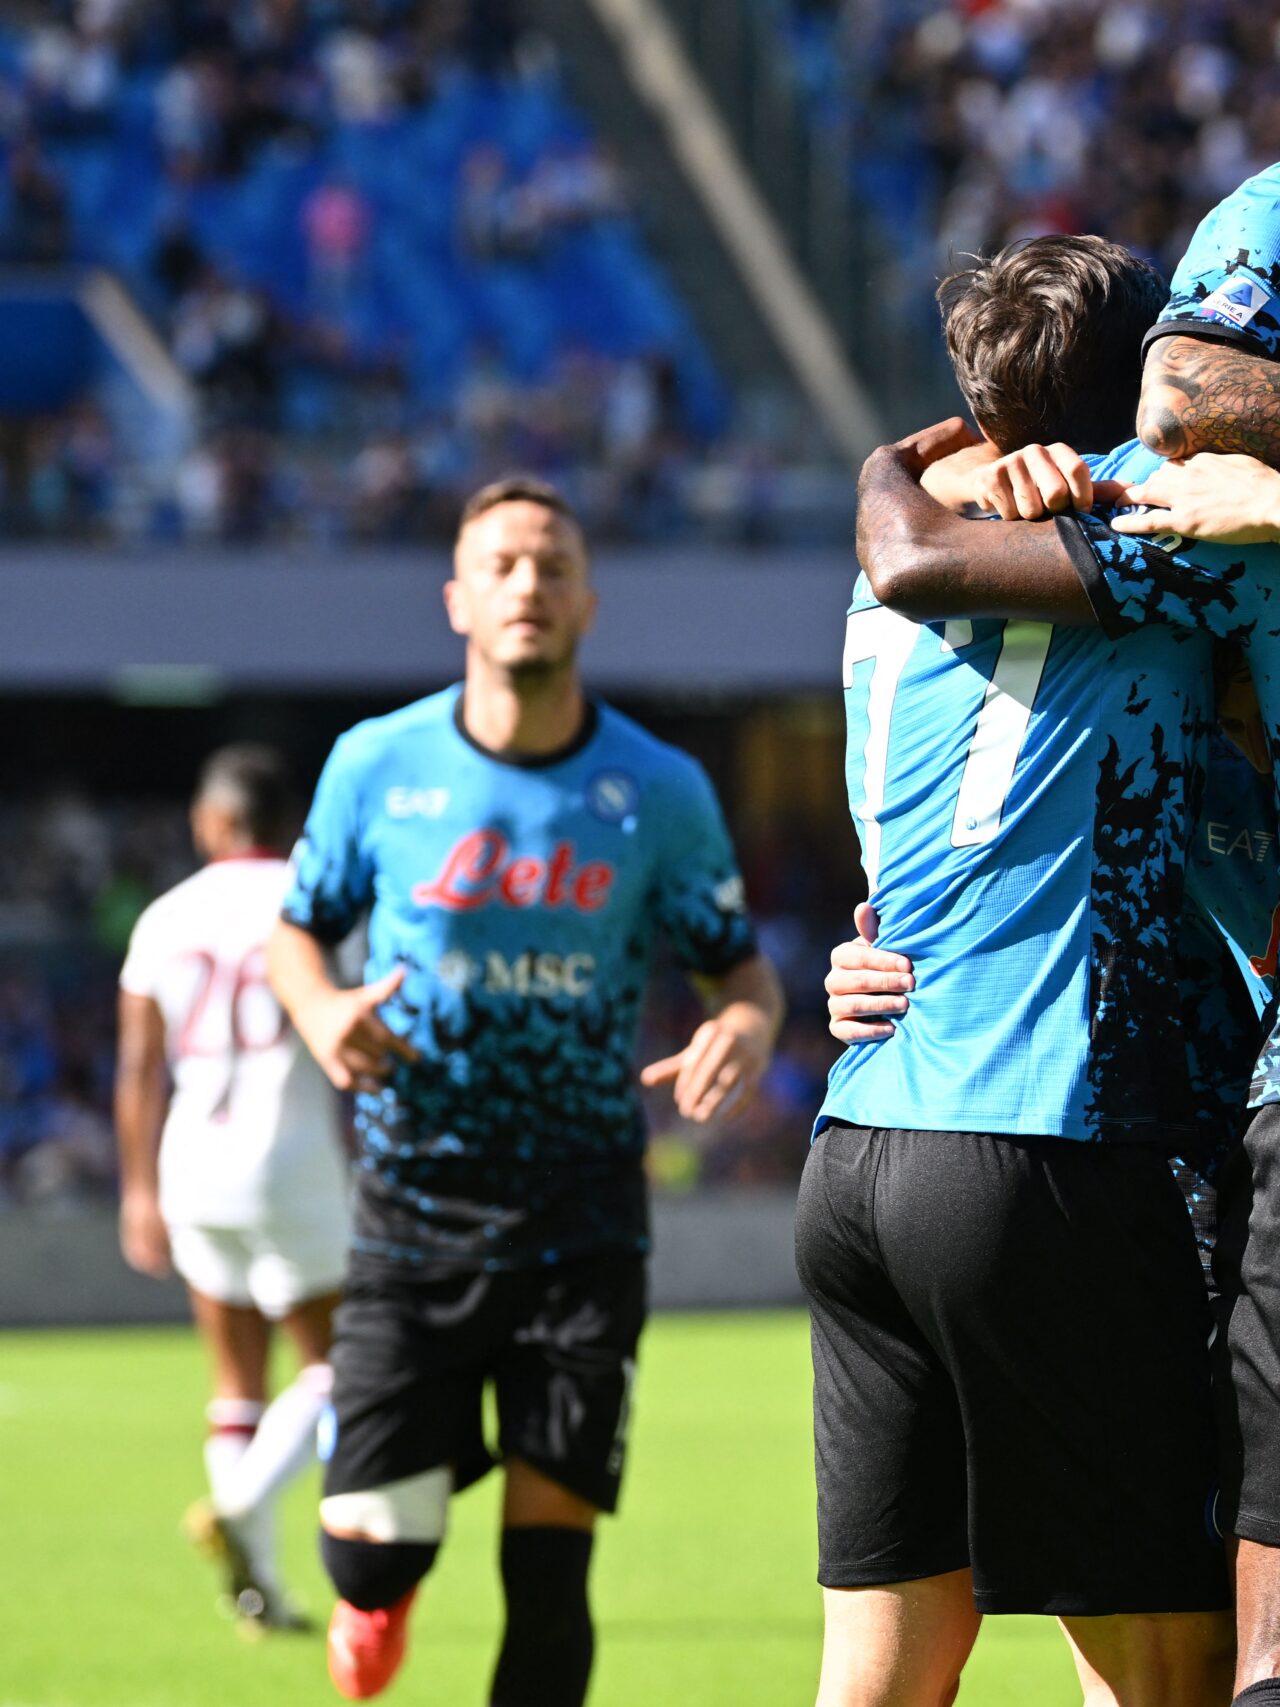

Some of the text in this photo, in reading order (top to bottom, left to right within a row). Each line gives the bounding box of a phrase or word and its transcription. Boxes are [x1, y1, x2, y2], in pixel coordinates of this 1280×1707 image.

[1207, 821, 1275, 862] EA7
[413, 828, 614, 911] Lete
[485, 949, 594, 998] MSC
